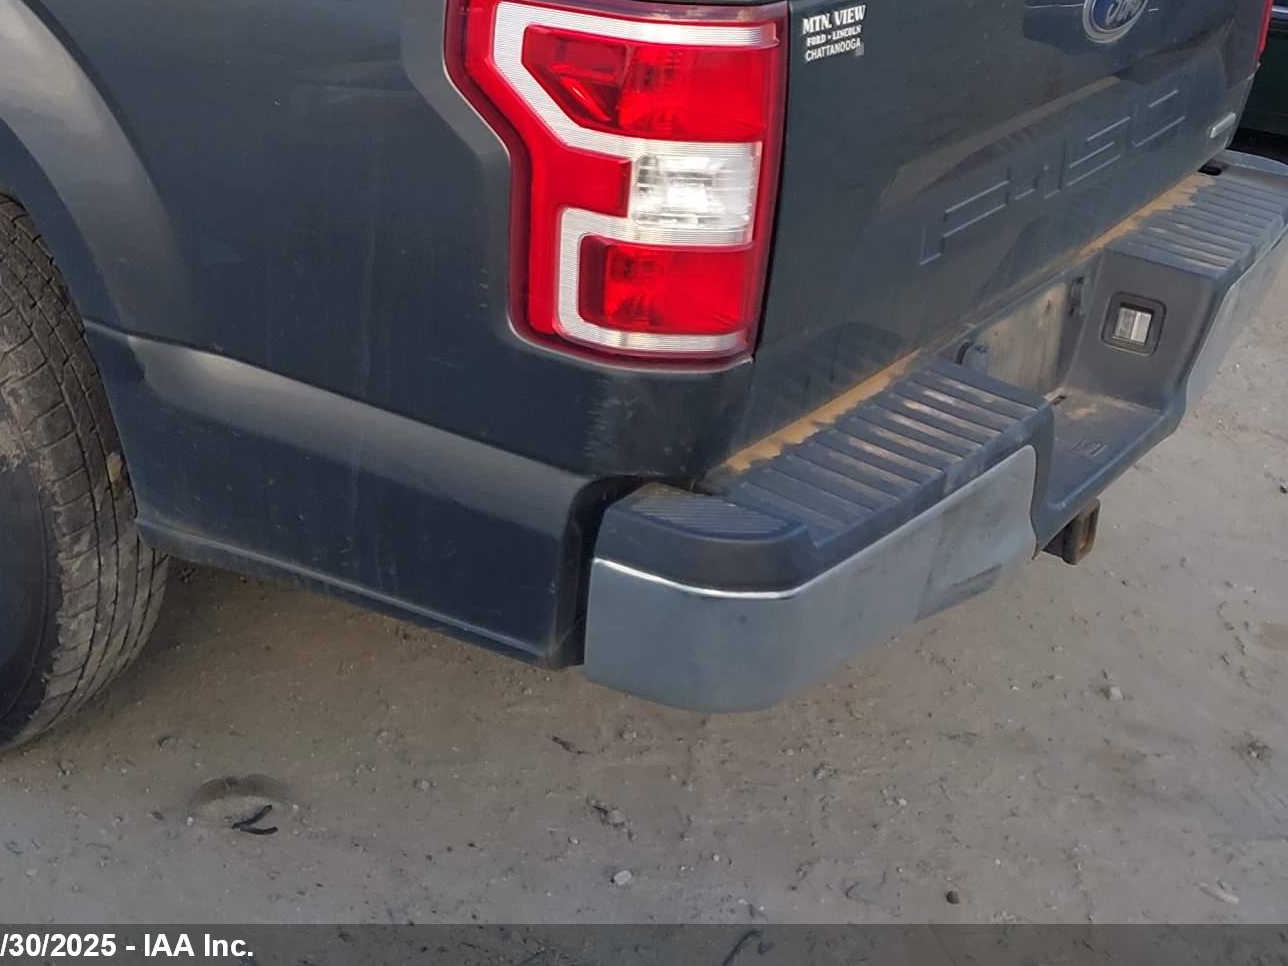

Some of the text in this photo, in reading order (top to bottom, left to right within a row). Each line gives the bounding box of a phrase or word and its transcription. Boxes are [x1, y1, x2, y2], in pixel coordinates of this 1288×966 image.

[834, 5, 866, 26] VIEW
[807, 25, 862, 47] FORD LINCOLN
[805, 38, 861, 62] CHATTANOOGA
